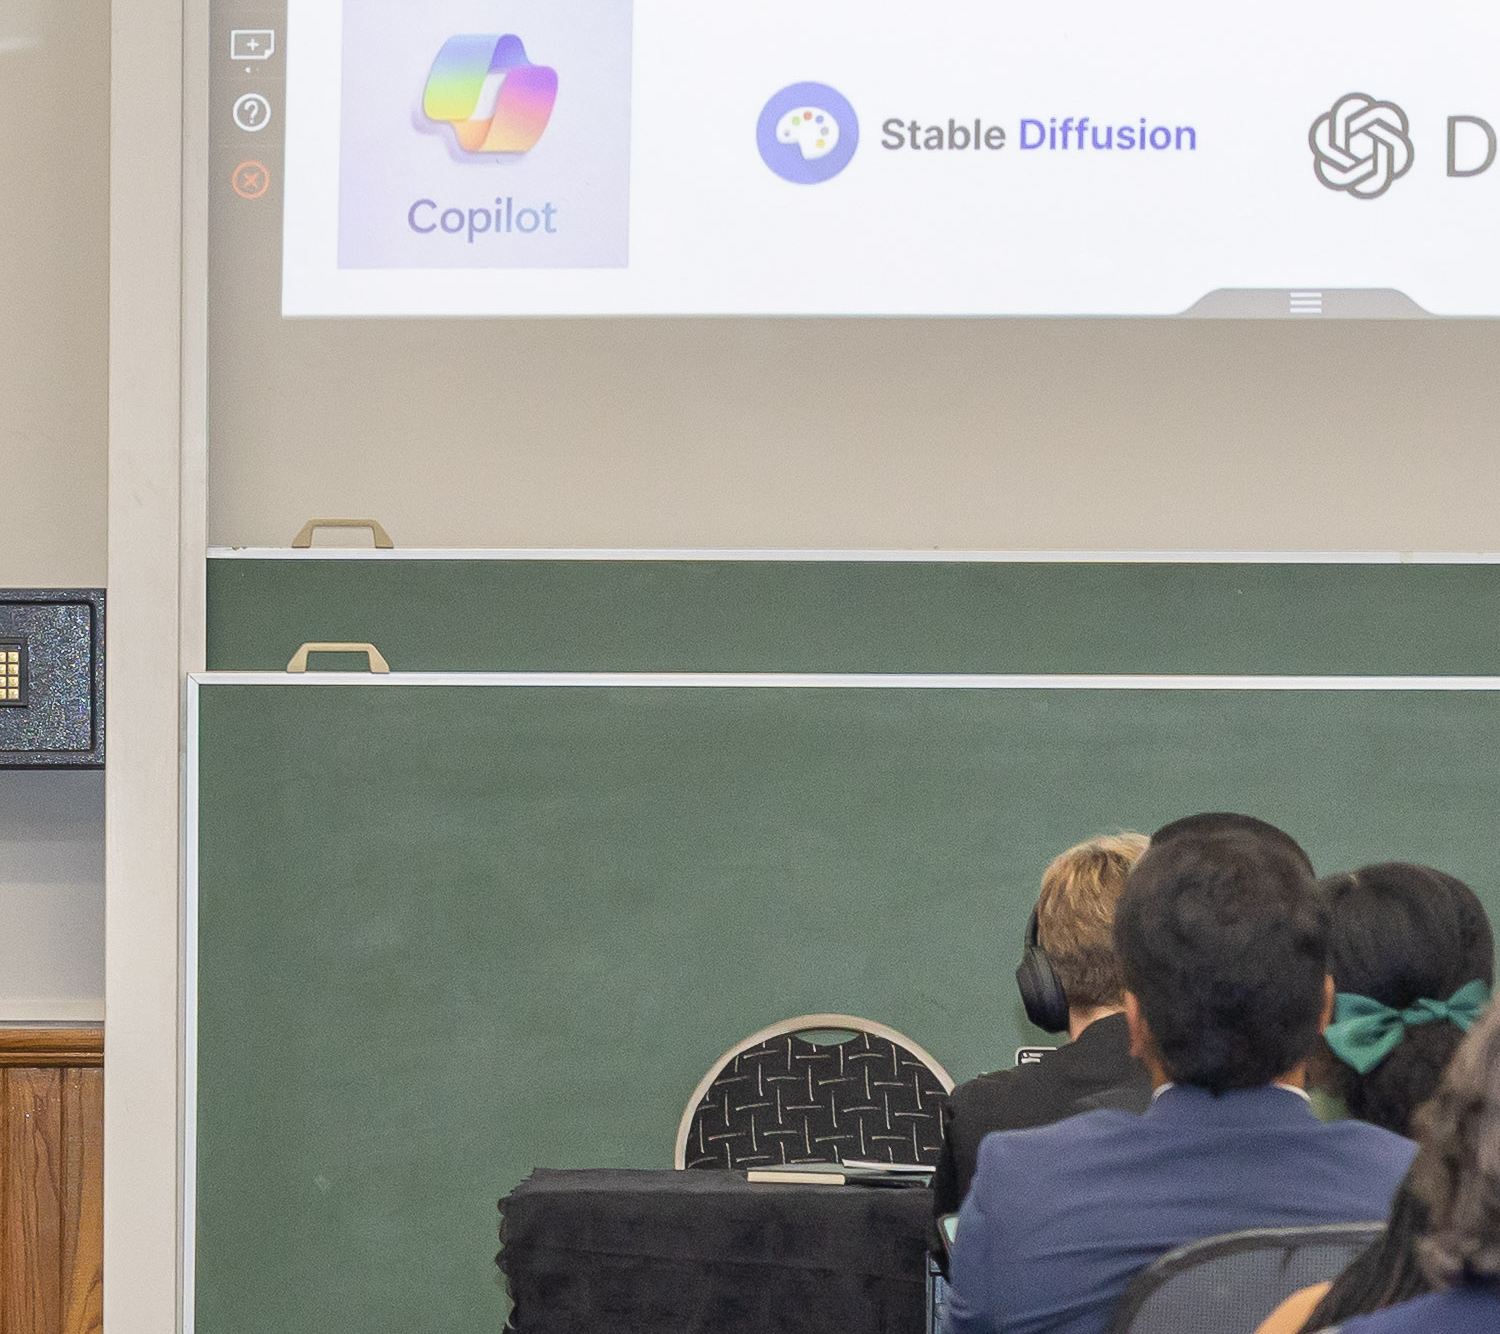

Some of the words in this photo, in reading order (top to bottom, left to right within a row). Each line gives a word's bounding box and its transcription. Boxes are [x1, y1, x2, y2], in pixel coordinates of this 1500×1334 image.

[880, 117, 1007, 151] Stable
[1018, 116, 1197, 151] Diffusion
[406, 197, 558, 244] Copilot
